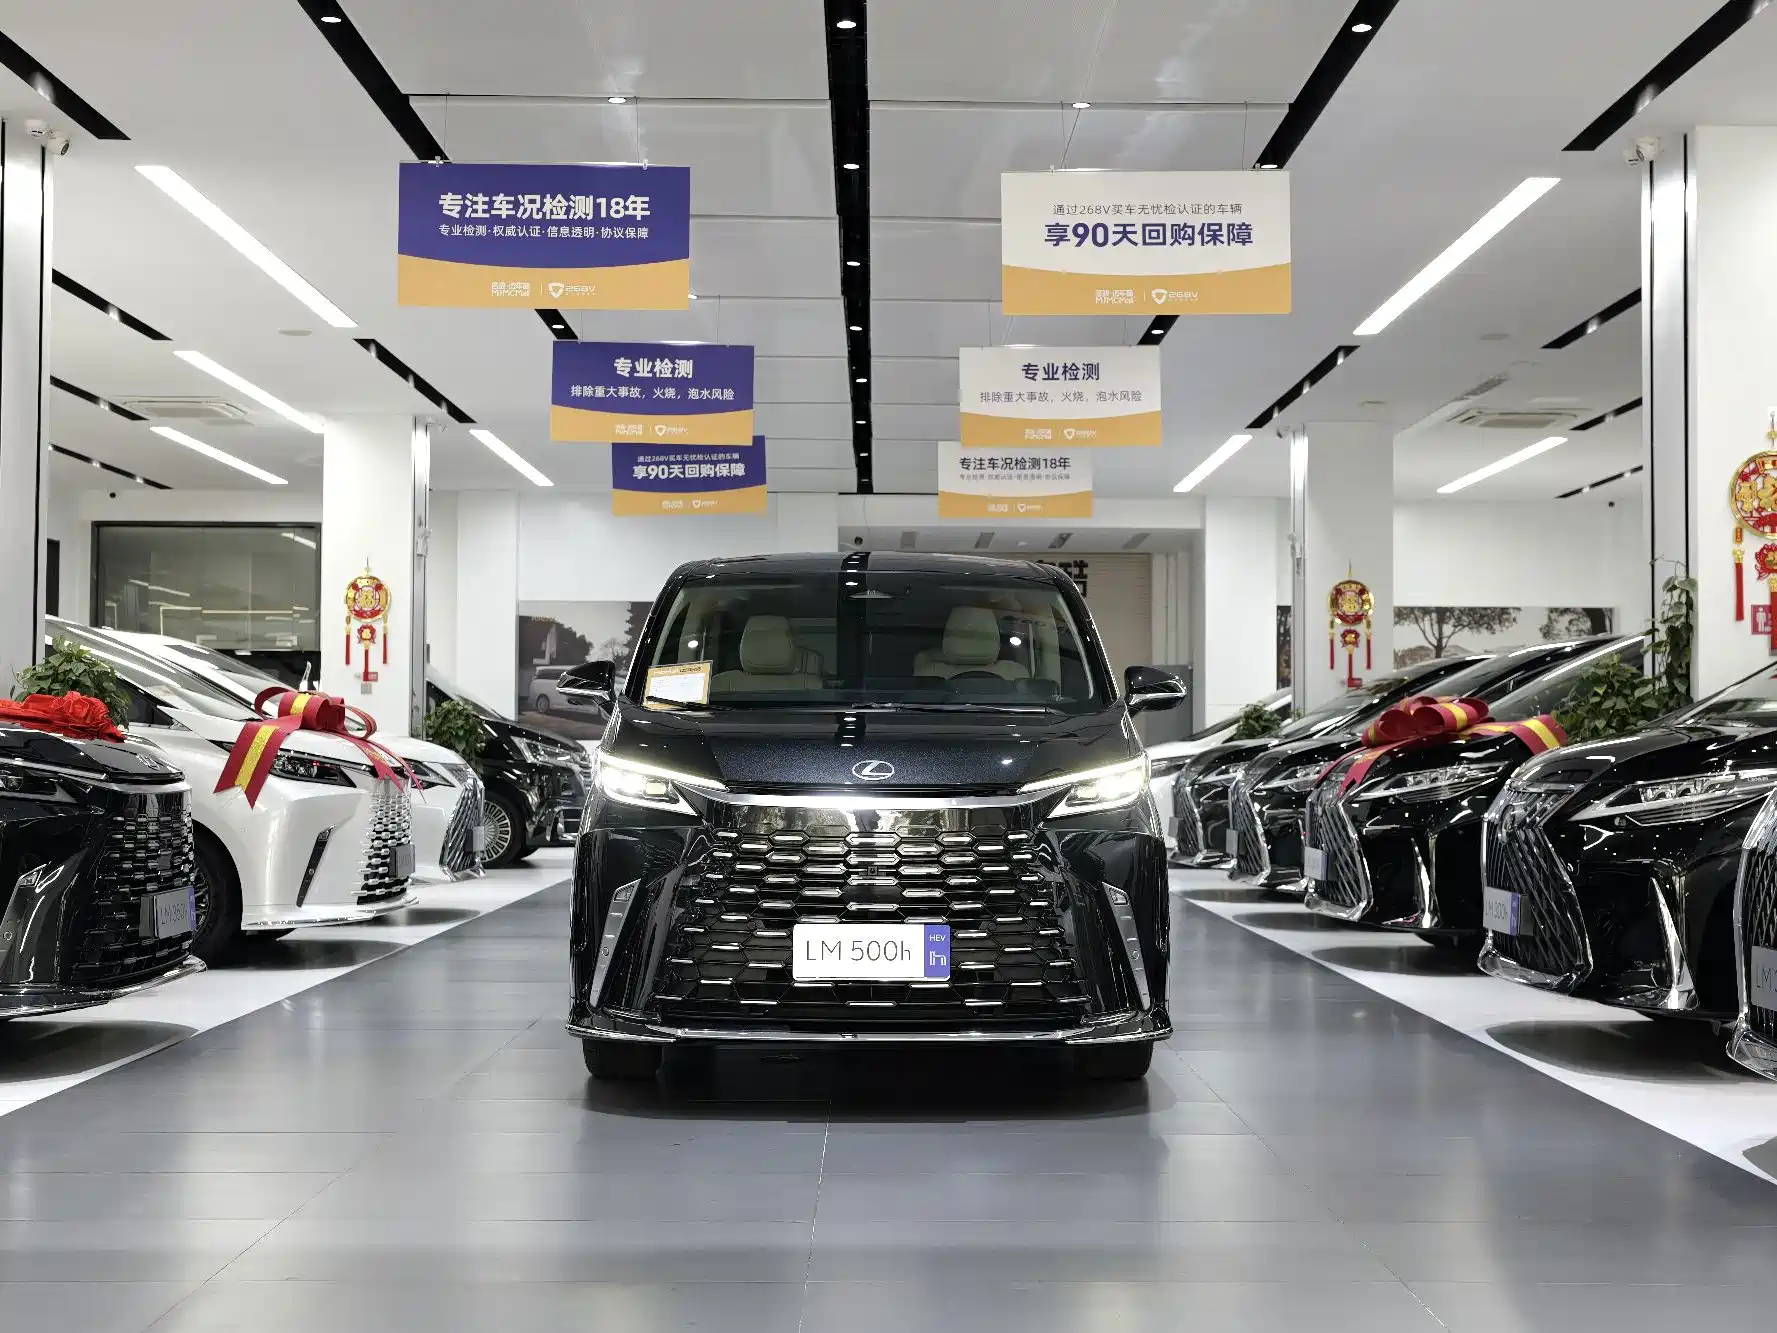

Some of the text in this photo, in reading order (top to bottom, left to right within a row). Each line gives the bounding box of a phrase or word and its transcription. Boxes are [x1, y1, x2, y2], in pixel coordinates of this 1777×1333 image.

[438, 192, 651, 221] 专注车况检测18年
[1052, 203, 1243, 215] 通过268V买车无忧检认证的车辆
[1044, 222, 1254, 247] 享90天回购保障
[613, 357, 694, 379] 专业检测
[1021, 362, 1100, 381] 专业检测
[570, 385, 735, 401] 排除重大事故，火烧，泡水风险
[632, 462, 746, 479] 享90天回购保障
[959, 456, 1071, 470] 专注车况检测18年
[929, 934, 946, 942] HEV
[806, 940, 911, 962] LM 500h
